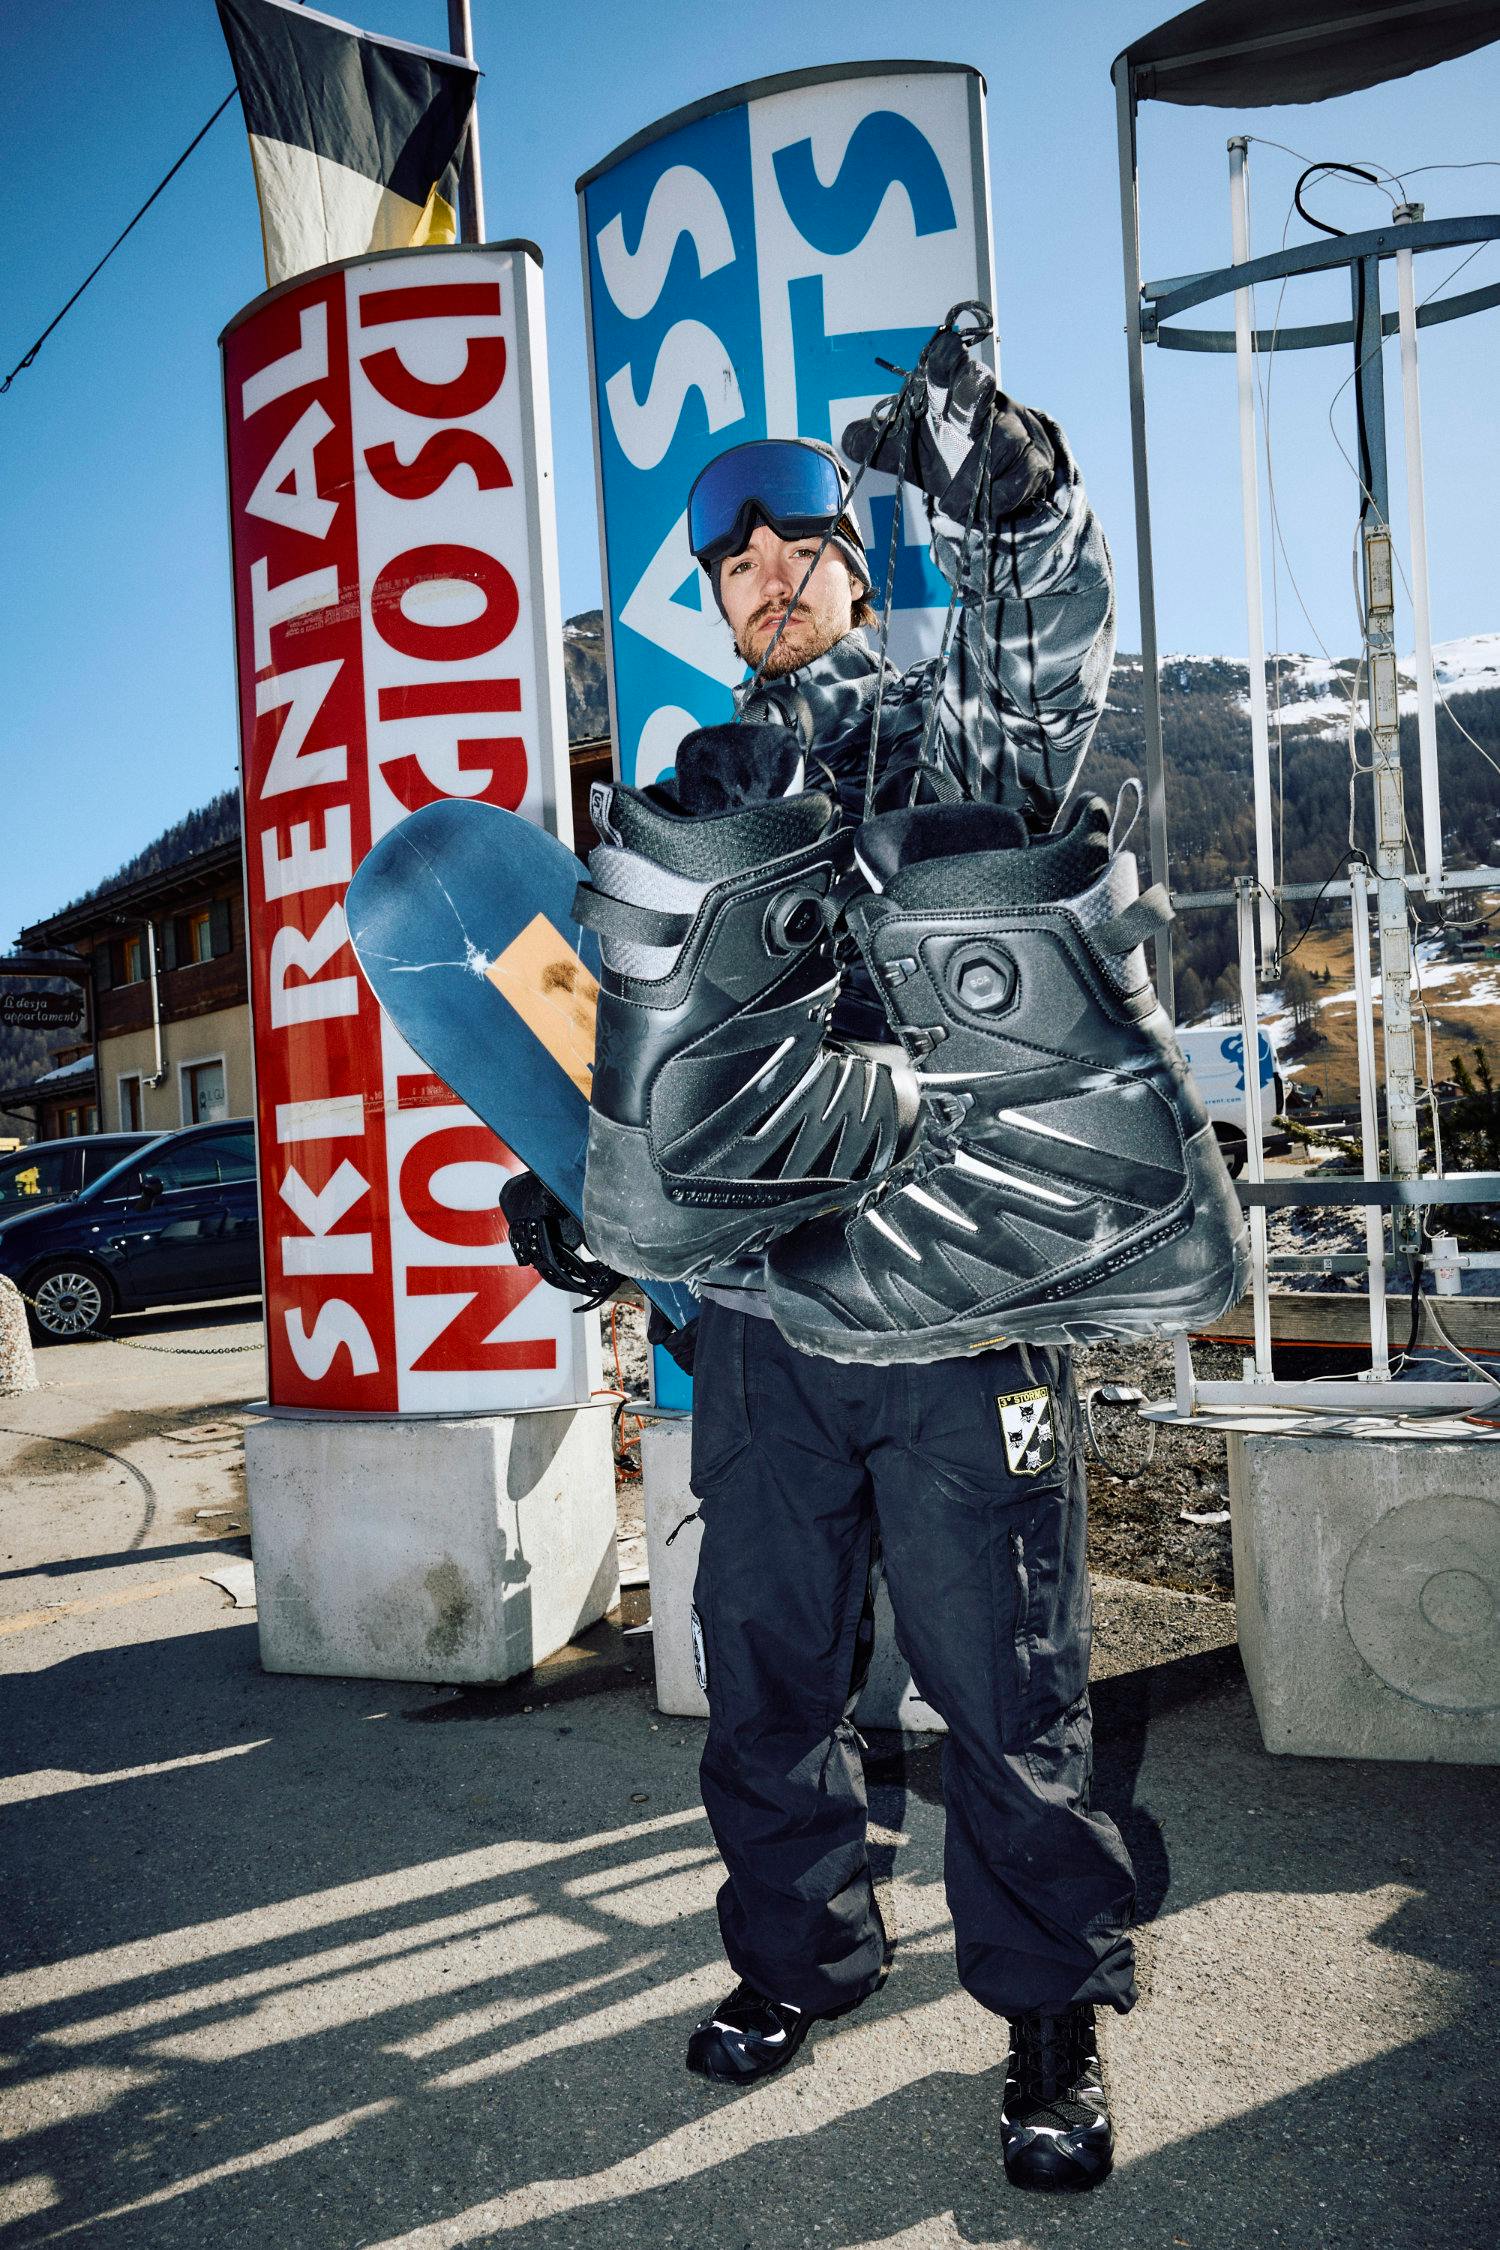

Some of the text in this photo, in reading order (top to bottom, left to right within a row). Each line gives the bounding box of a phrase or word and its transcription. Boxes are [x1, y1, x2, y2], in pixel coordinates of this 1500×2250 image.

[359, 282, 513, 500] SCI
[242, 301, 380, 1381] SKI RENTAL
[970, 976, 990, 987] BOA
[4, 1011, 79, 1024] appartamenti
[1013, 1389, 1048, 1404] STORMO
